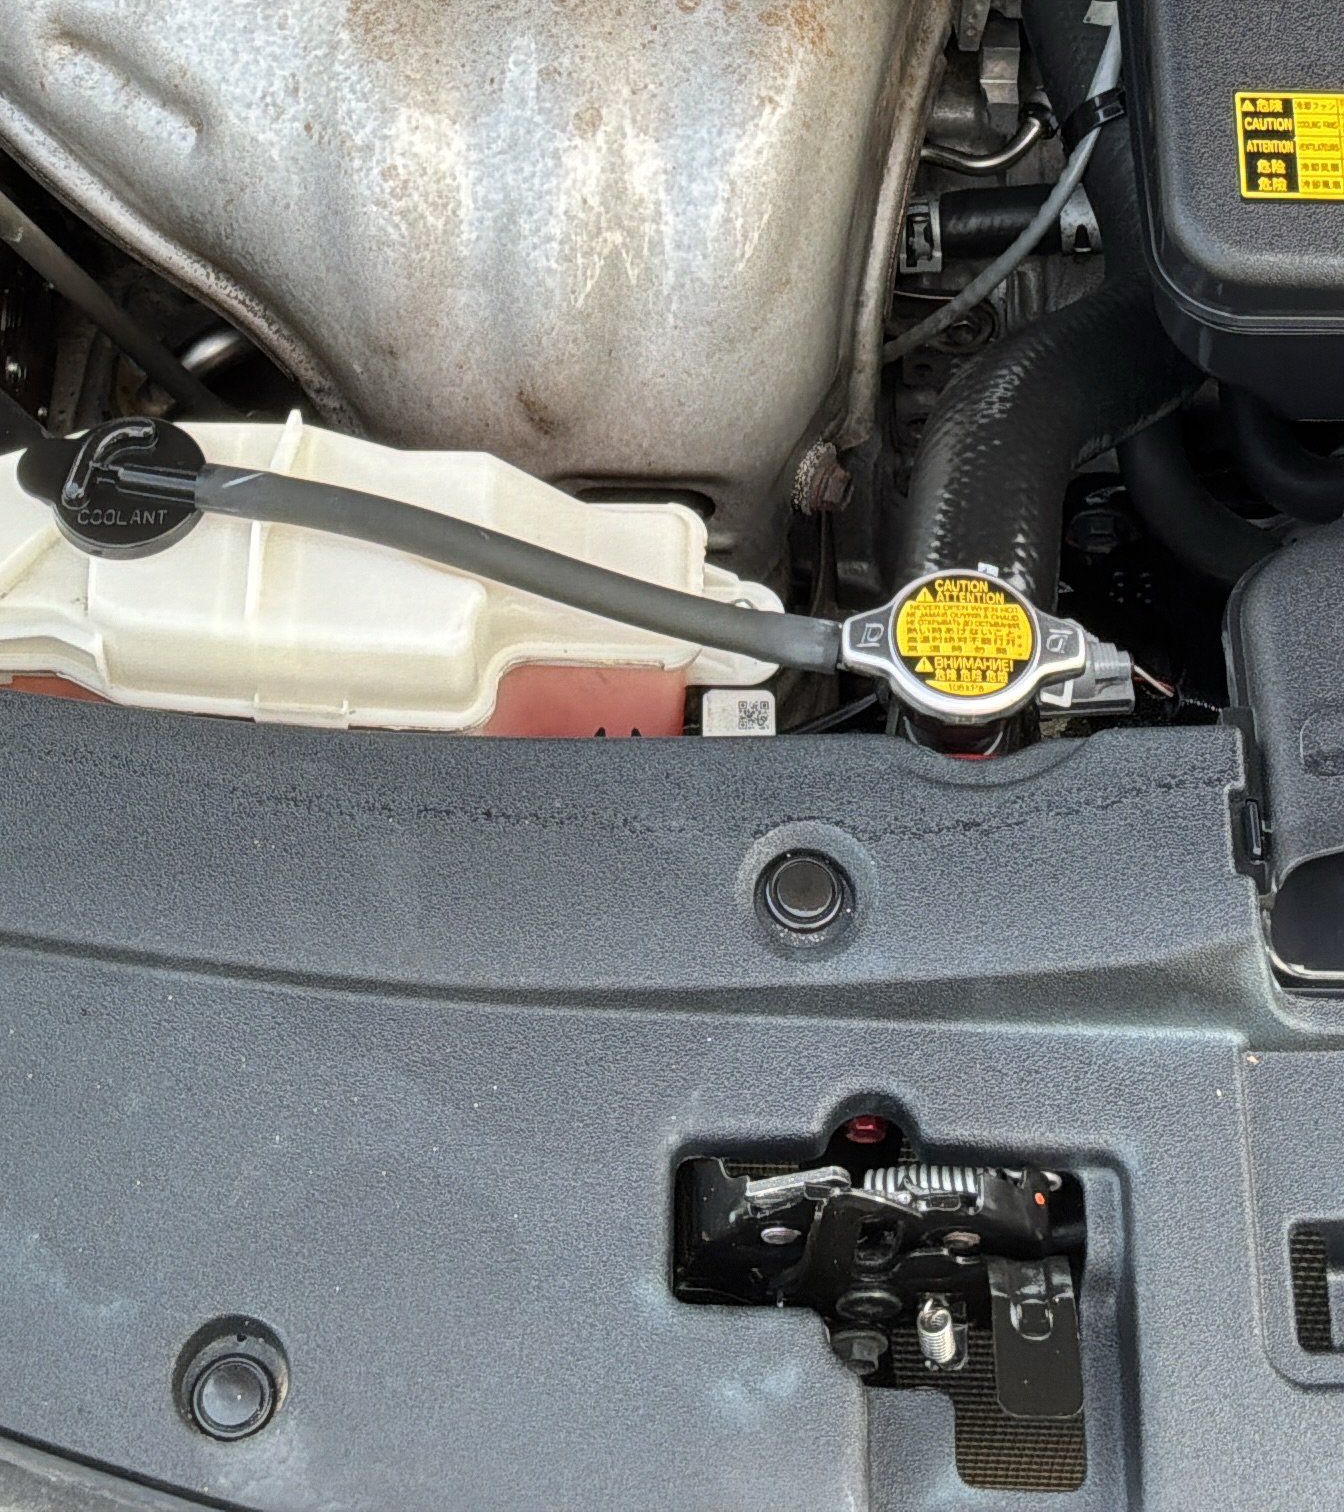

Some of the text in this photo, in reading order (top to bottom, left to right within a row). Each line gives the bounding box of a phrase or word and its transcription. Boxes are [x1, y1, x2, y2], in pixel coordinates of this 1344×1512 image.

[1244, 116, 1293, 131] CAUTION
[1246, 139, 1294, 153] ATTENTION
[77, 508, 168, 526] COOLANT
[935, 579, 989, 593] CAUTION
[935, 592, 1005, 604] ATTENTION
[934, 656, 1014, 672] ВНИМАНИЕ!
